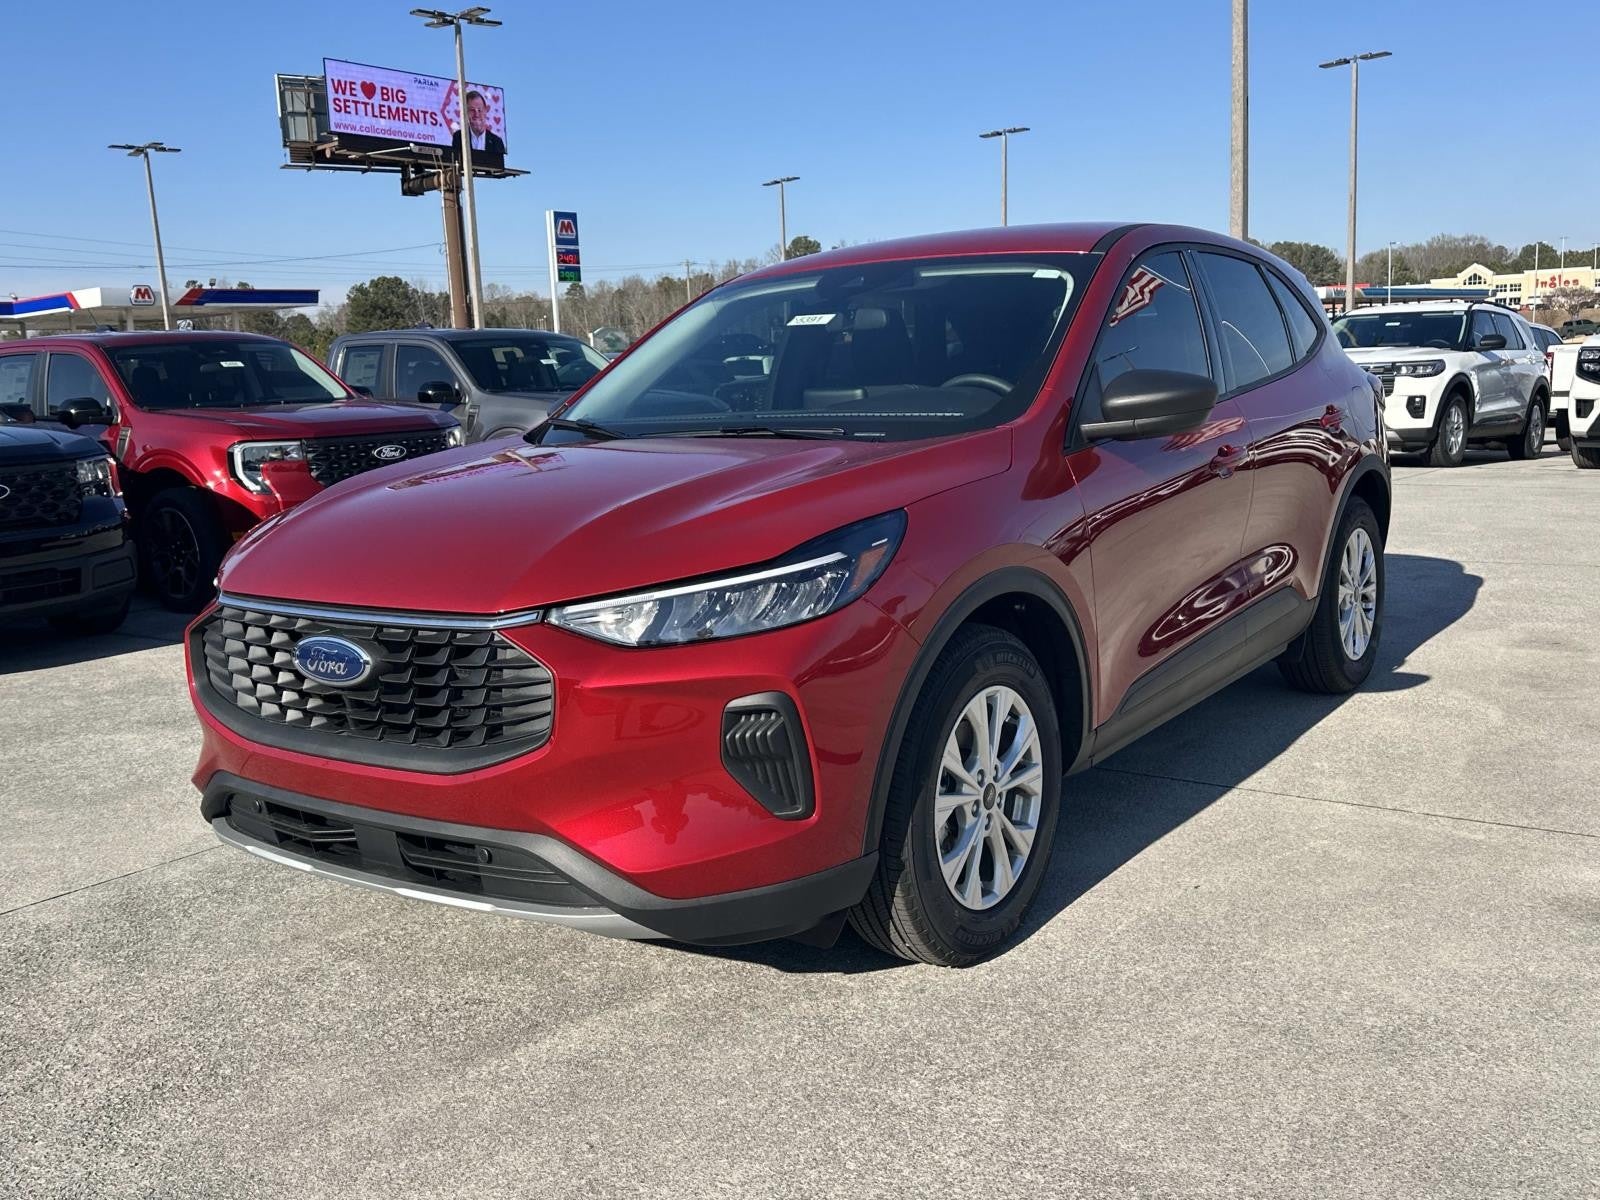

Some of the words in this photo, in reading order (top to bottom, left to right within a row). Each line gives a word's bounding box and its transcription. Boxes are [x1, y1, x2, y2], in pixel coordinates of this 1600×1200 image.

[331, 78, 357, 97] WE
[381, 86, 406, 104] BIG
[413, 77, 439, 87] PARIAN
[333, 97, 442, 127] SETTLEMENTS.
[334, 121, 436, 142] www.callcadenow.com
[380, 447, 401, 458] Ford
[307, 646, 348, 675] Ford
